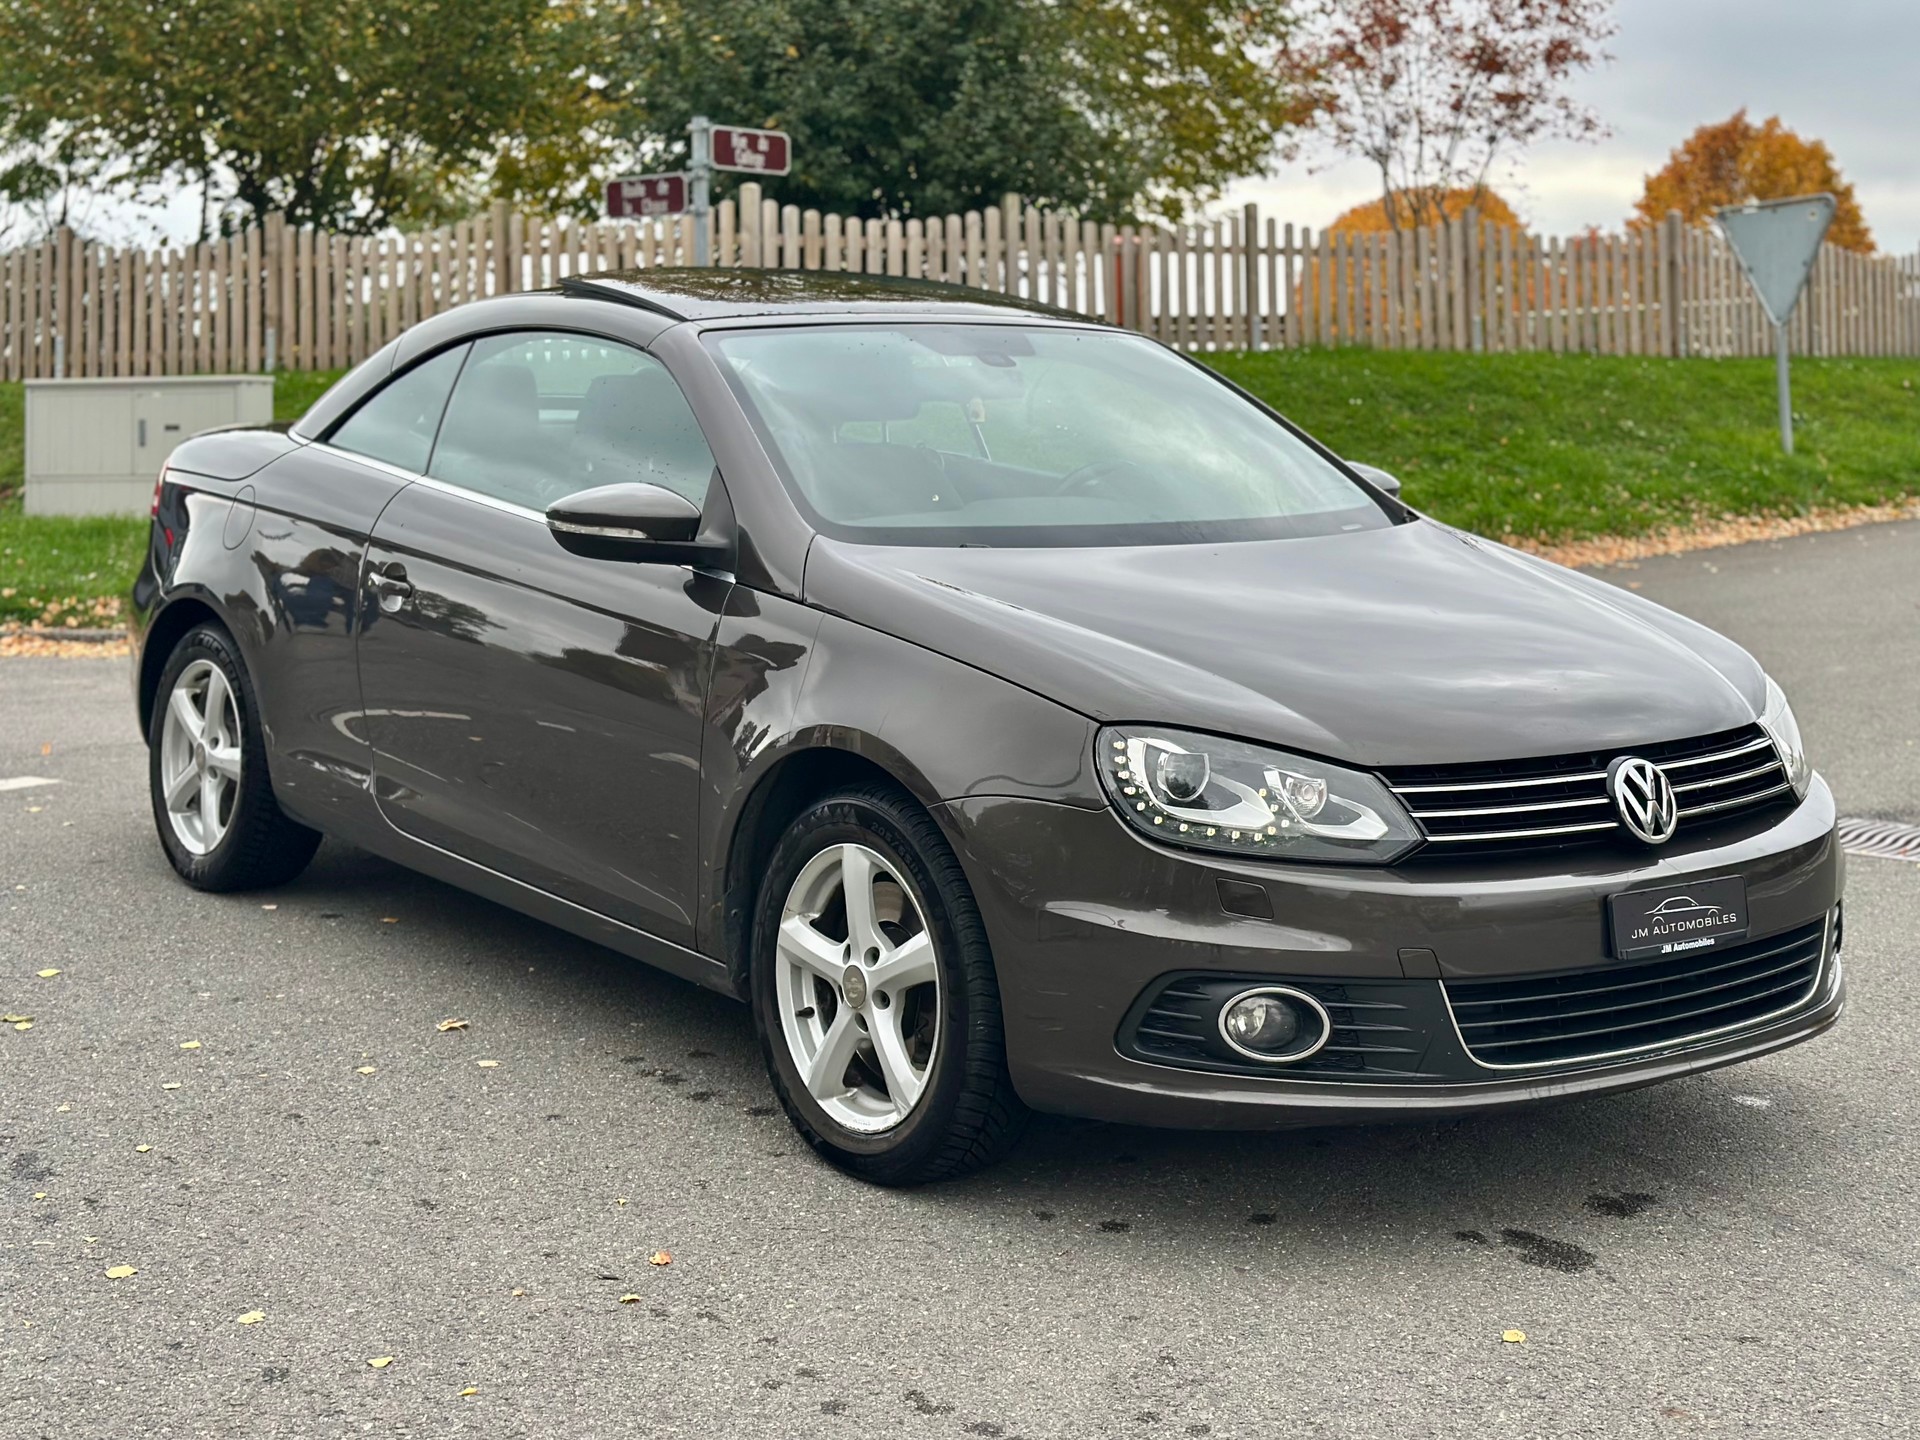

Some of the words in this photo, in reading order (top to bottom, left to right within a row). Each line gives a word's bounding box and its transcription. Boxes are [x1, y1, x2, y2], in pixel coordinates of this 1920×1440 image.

[1631, 929, 1649, 939] JM
[1653, 912, 1737, 935] AUTOMOBILES
[1661, 943, 1673, 954] JM
[1673, 938, 1715, 953] Automobiles
